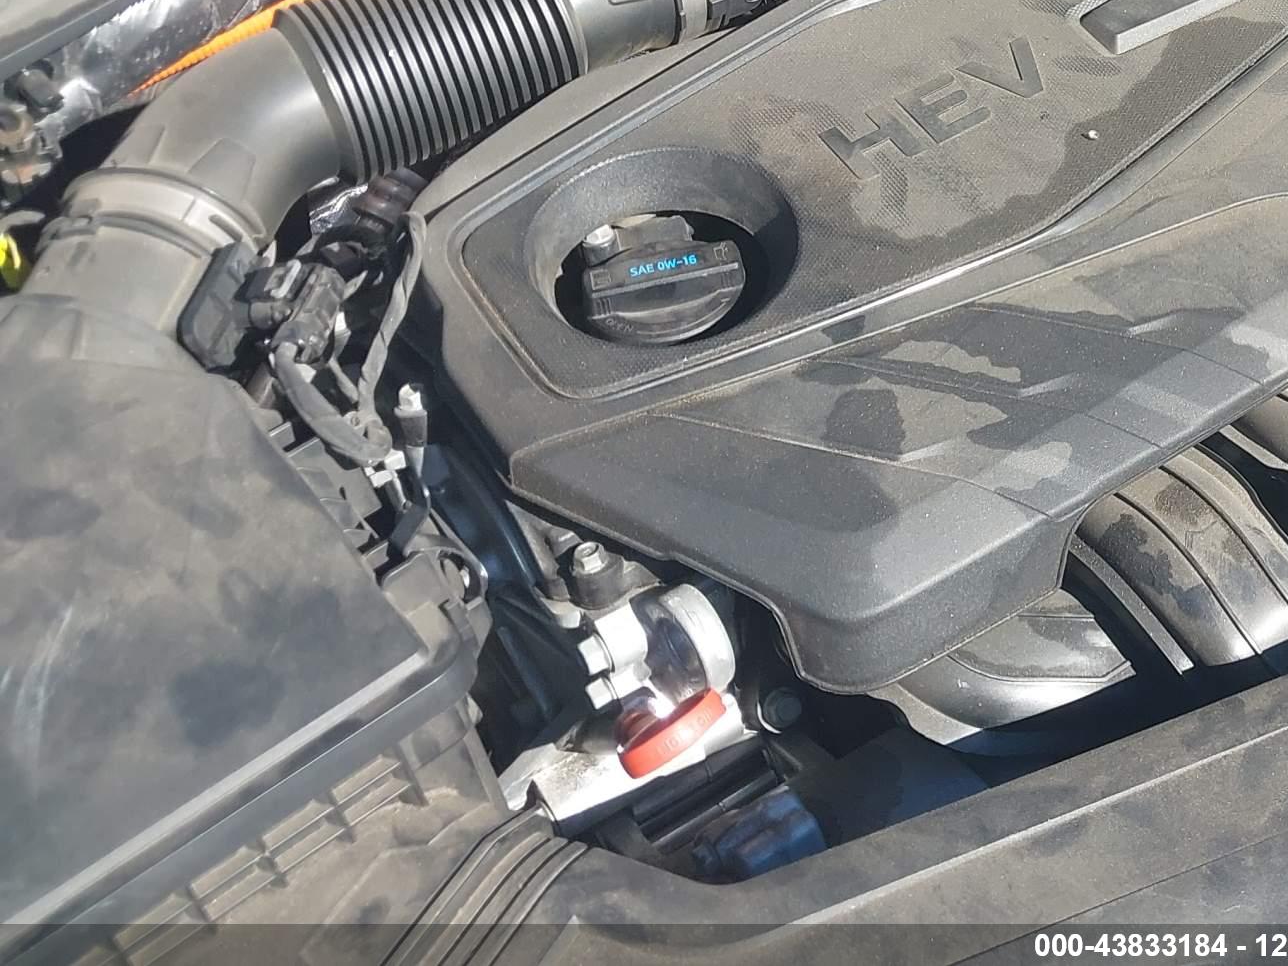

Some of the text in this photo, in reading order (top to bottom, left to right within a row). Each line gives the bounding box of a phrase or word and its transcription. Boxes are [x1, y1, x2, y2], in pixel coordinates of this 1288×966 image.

[819, 35, 1044, 181] HEV
[629, 254, 698, 277] SAE 0W-16
